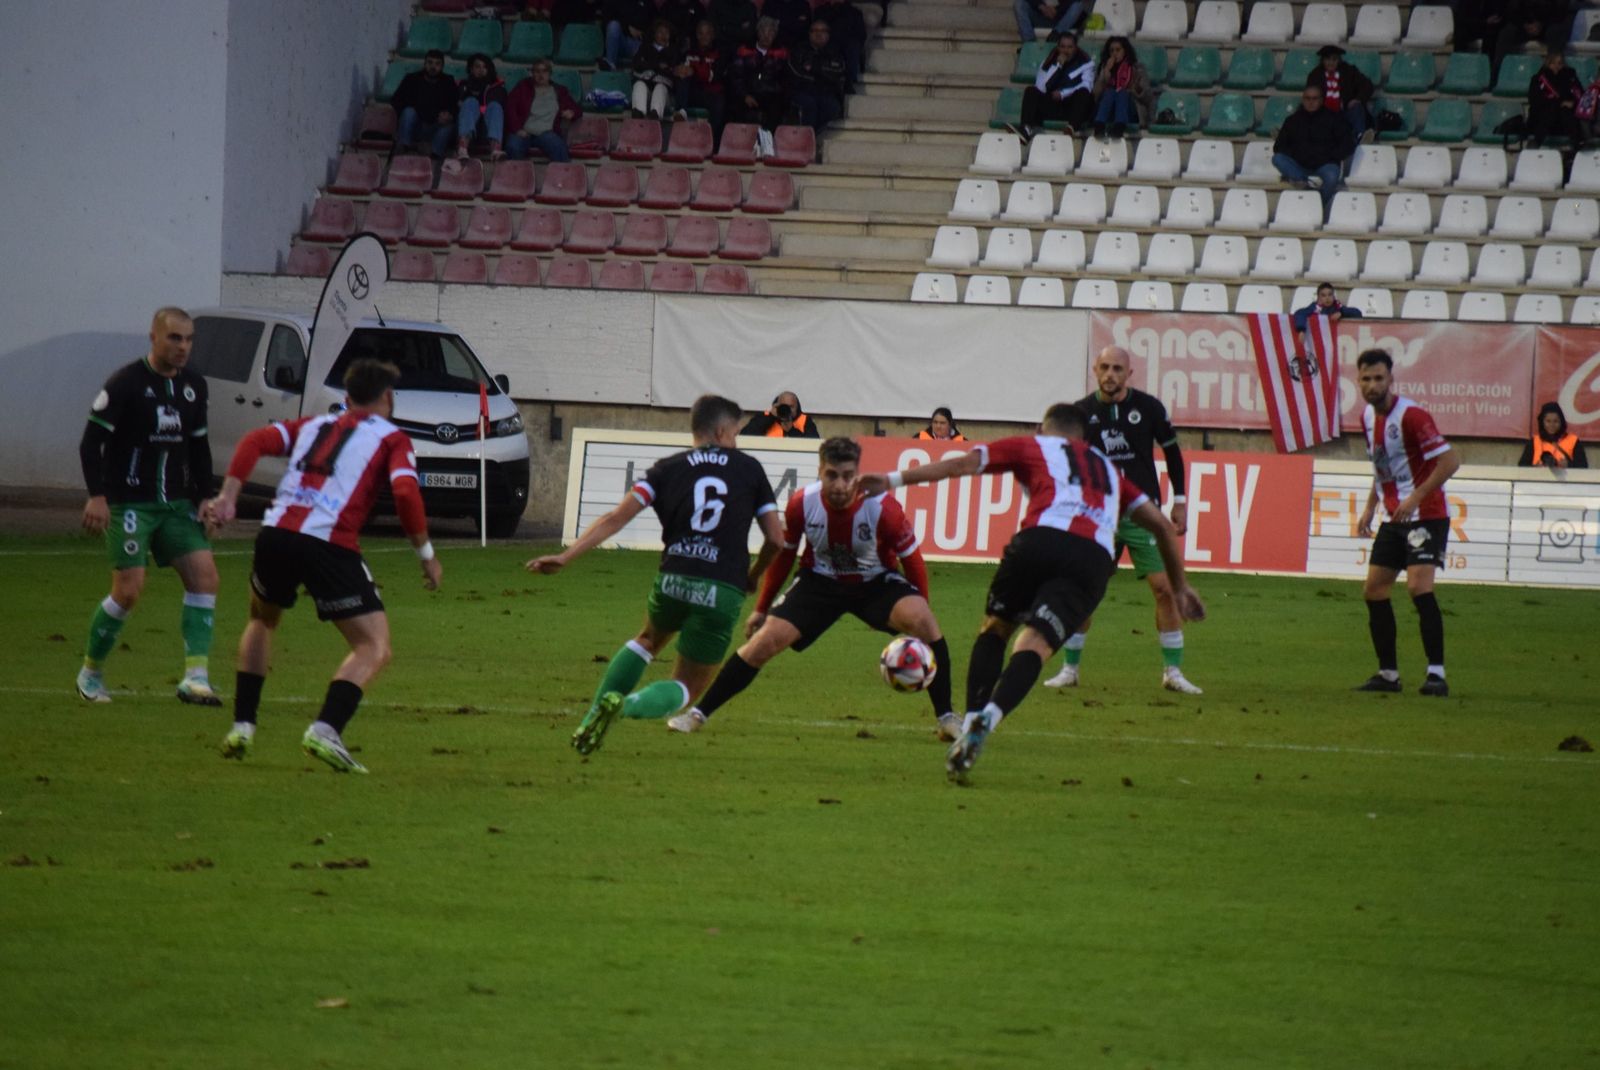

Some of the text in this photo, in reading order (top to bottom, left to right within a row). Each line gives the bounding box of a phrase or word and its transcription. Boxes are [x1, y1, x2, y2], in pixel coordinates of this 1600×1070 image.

[1431, 381, 1512, 398] UBICACIÓN
[1475, 402, 1511, 417] Viejo
[426, 475, 474, 488] 6964 MGR
[690, 476, 728, 533] 6
[894, 448, 1032, 552] COP
[123, 509, 137, 534] 8
